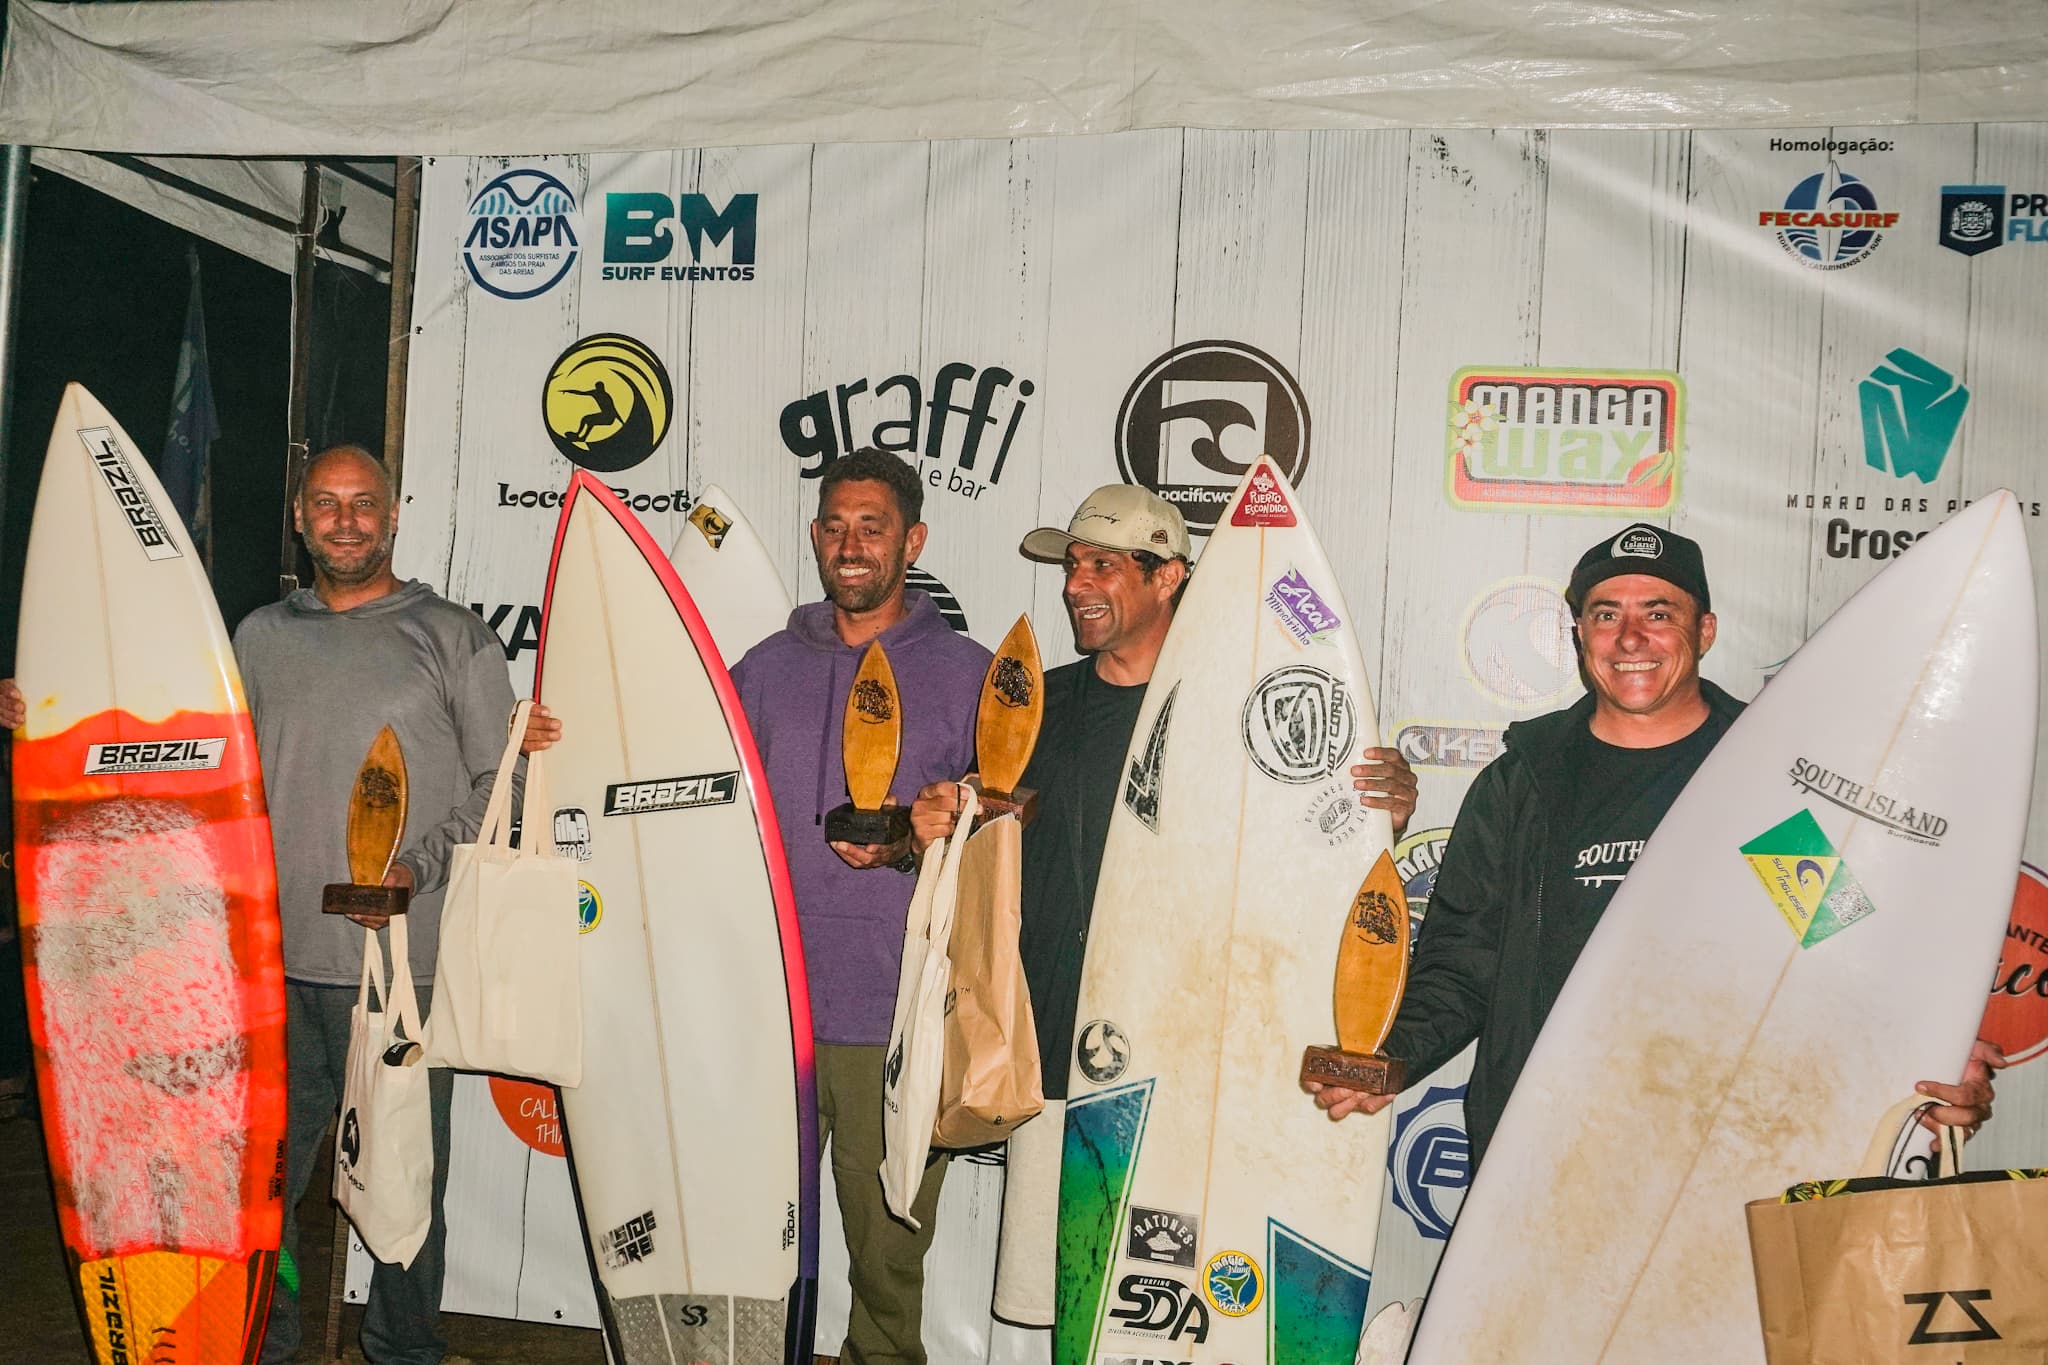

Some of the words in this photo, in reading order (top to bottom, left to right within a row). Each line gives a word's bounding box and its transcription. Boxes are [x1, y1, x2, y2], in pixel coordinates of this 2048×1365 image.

[1770, 138, 1894, 154] Homologação:
[464, 214, 579, 248] ASAPA
[1759, 211, 1900, 229] FECASURF
[602, 267, 655, 281] SURF
[661, 266, 755, 281] EVENTOS
[779, 362, 1035, 480] graffi
[947, 467, 987, 501] bar
[1250, 491, 1282, 504] PUERTO
[1786, 495, 1866, 511] MORRO
[1885, 498, 1928, 513] DAS
[1245, 503, 1288, 516] ESCONDIDO
[1624, 541, 1657, 549] Island
[1789, 757, 1864, 805] SOUTH
[1865, 790, 1949, 838] ISLAND
[1575, 840, 1646, 869] SOUTH
[787, 1200, 796, 1248] TODAY
[1109, 1275, 1210, 1344] SDA
